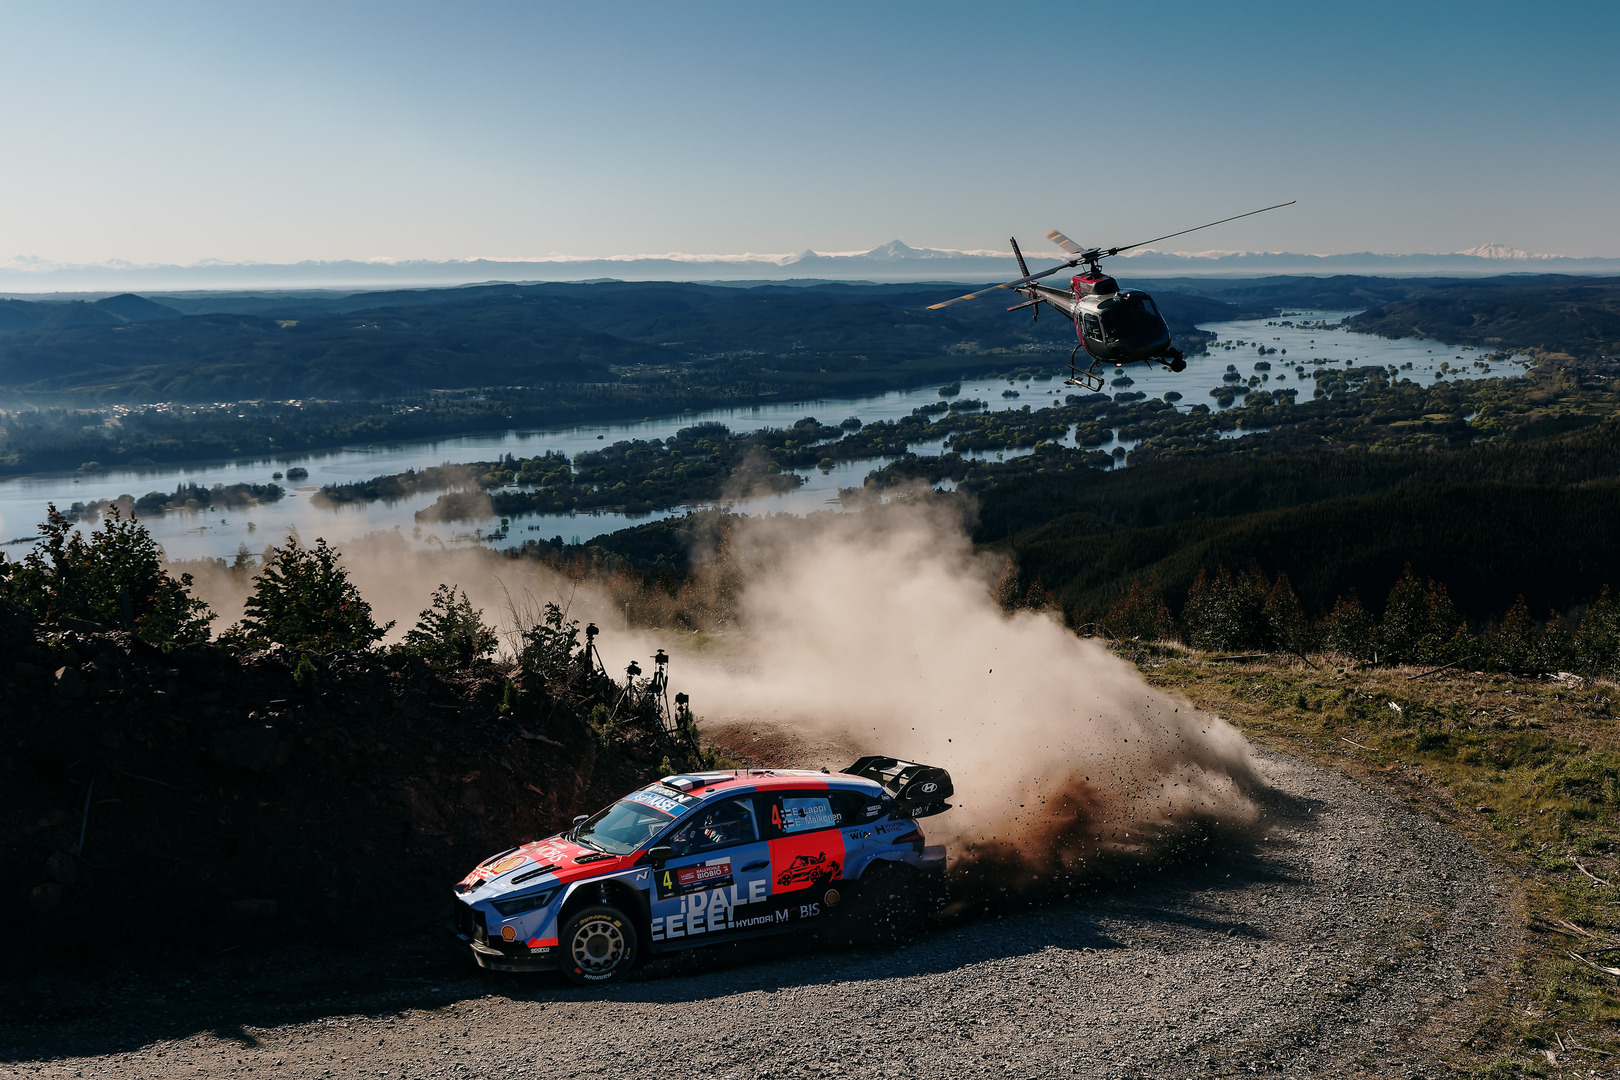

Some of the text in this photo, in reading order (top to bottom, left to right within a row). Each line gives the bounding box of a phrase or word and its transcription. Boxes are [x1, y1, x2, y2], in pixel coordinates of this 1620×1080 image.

[771, 804, 782, 830] 4
[803, 803, 827, 815] Lappi
[663, 870, 673, 890] 4
[735, 914, 774, 928] HYUNDAI
